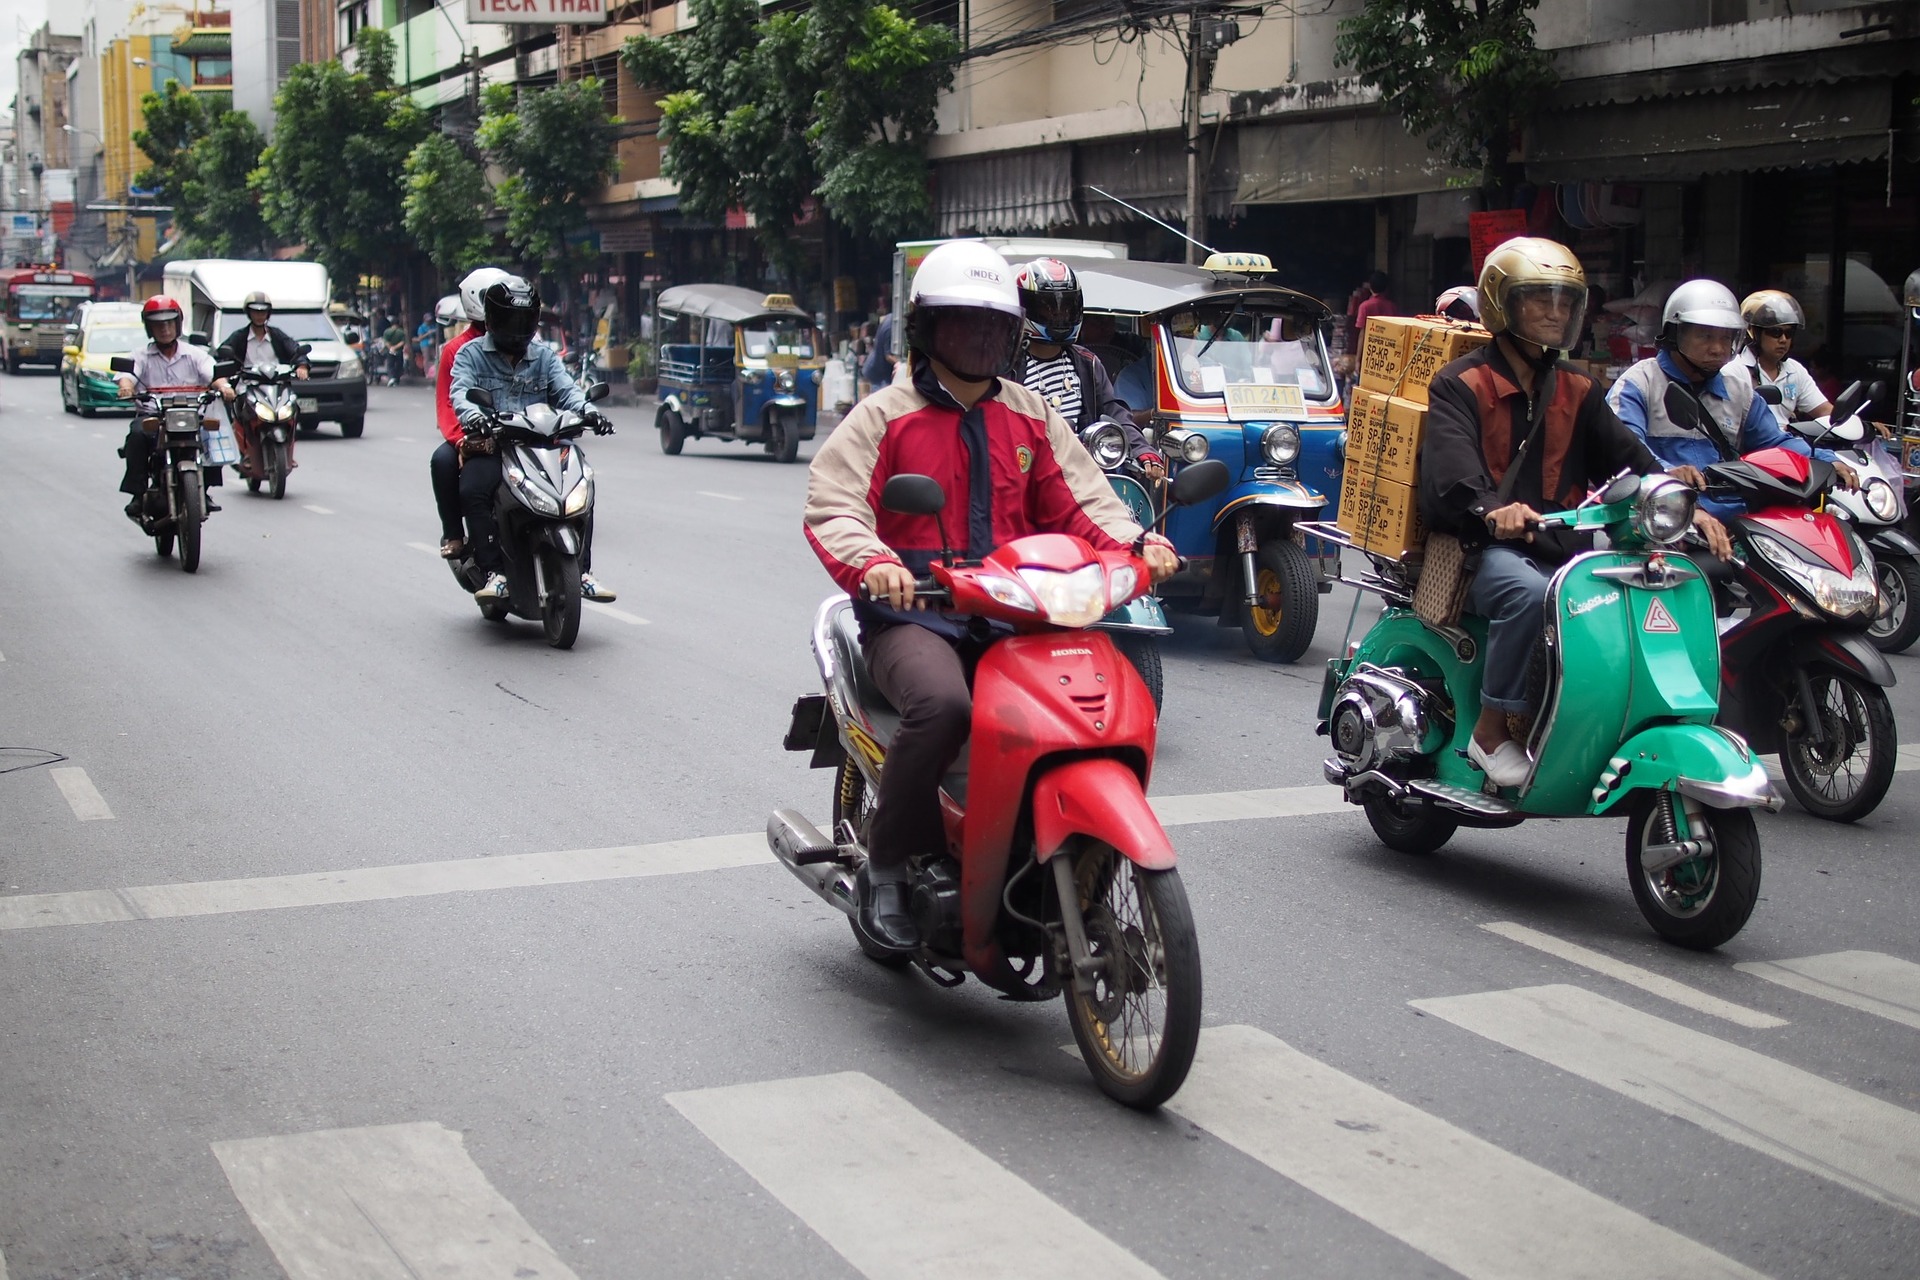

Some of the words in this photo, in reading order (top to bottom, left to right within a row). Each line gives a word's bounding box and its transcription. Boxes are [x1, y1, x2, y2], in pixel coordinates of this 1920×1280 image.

[1223, 255, 1265, 267] TAXI
[970, 269, 1000, 282] INDEX
[1367, 336, 1384, 346] SUPER
[1385, 340, 1396, 349] LINE
[1366, 344, 1389, 360] SP-KR
[1431, 349, 1443, 358] LINE
[1365, 356, 1384, 371] 1/3HP
[1385, 361, 1396, 375] 4P
[1409, 364, 1431, 380] 1/3HP
[1260, 387, 1298, 405] 2411
[1387, 424, 1398, 434] LINE
[1387, 446, 1398, 460] 4P
[1359, 491, 1376, 501] SUP
[1376, 496, 1389, 506] LINE
[1357, 511, 1378, 529] 1/3P
[1378, 518, 1389, 532] 4P
[1050, 648, 1094, 658] HONDA
